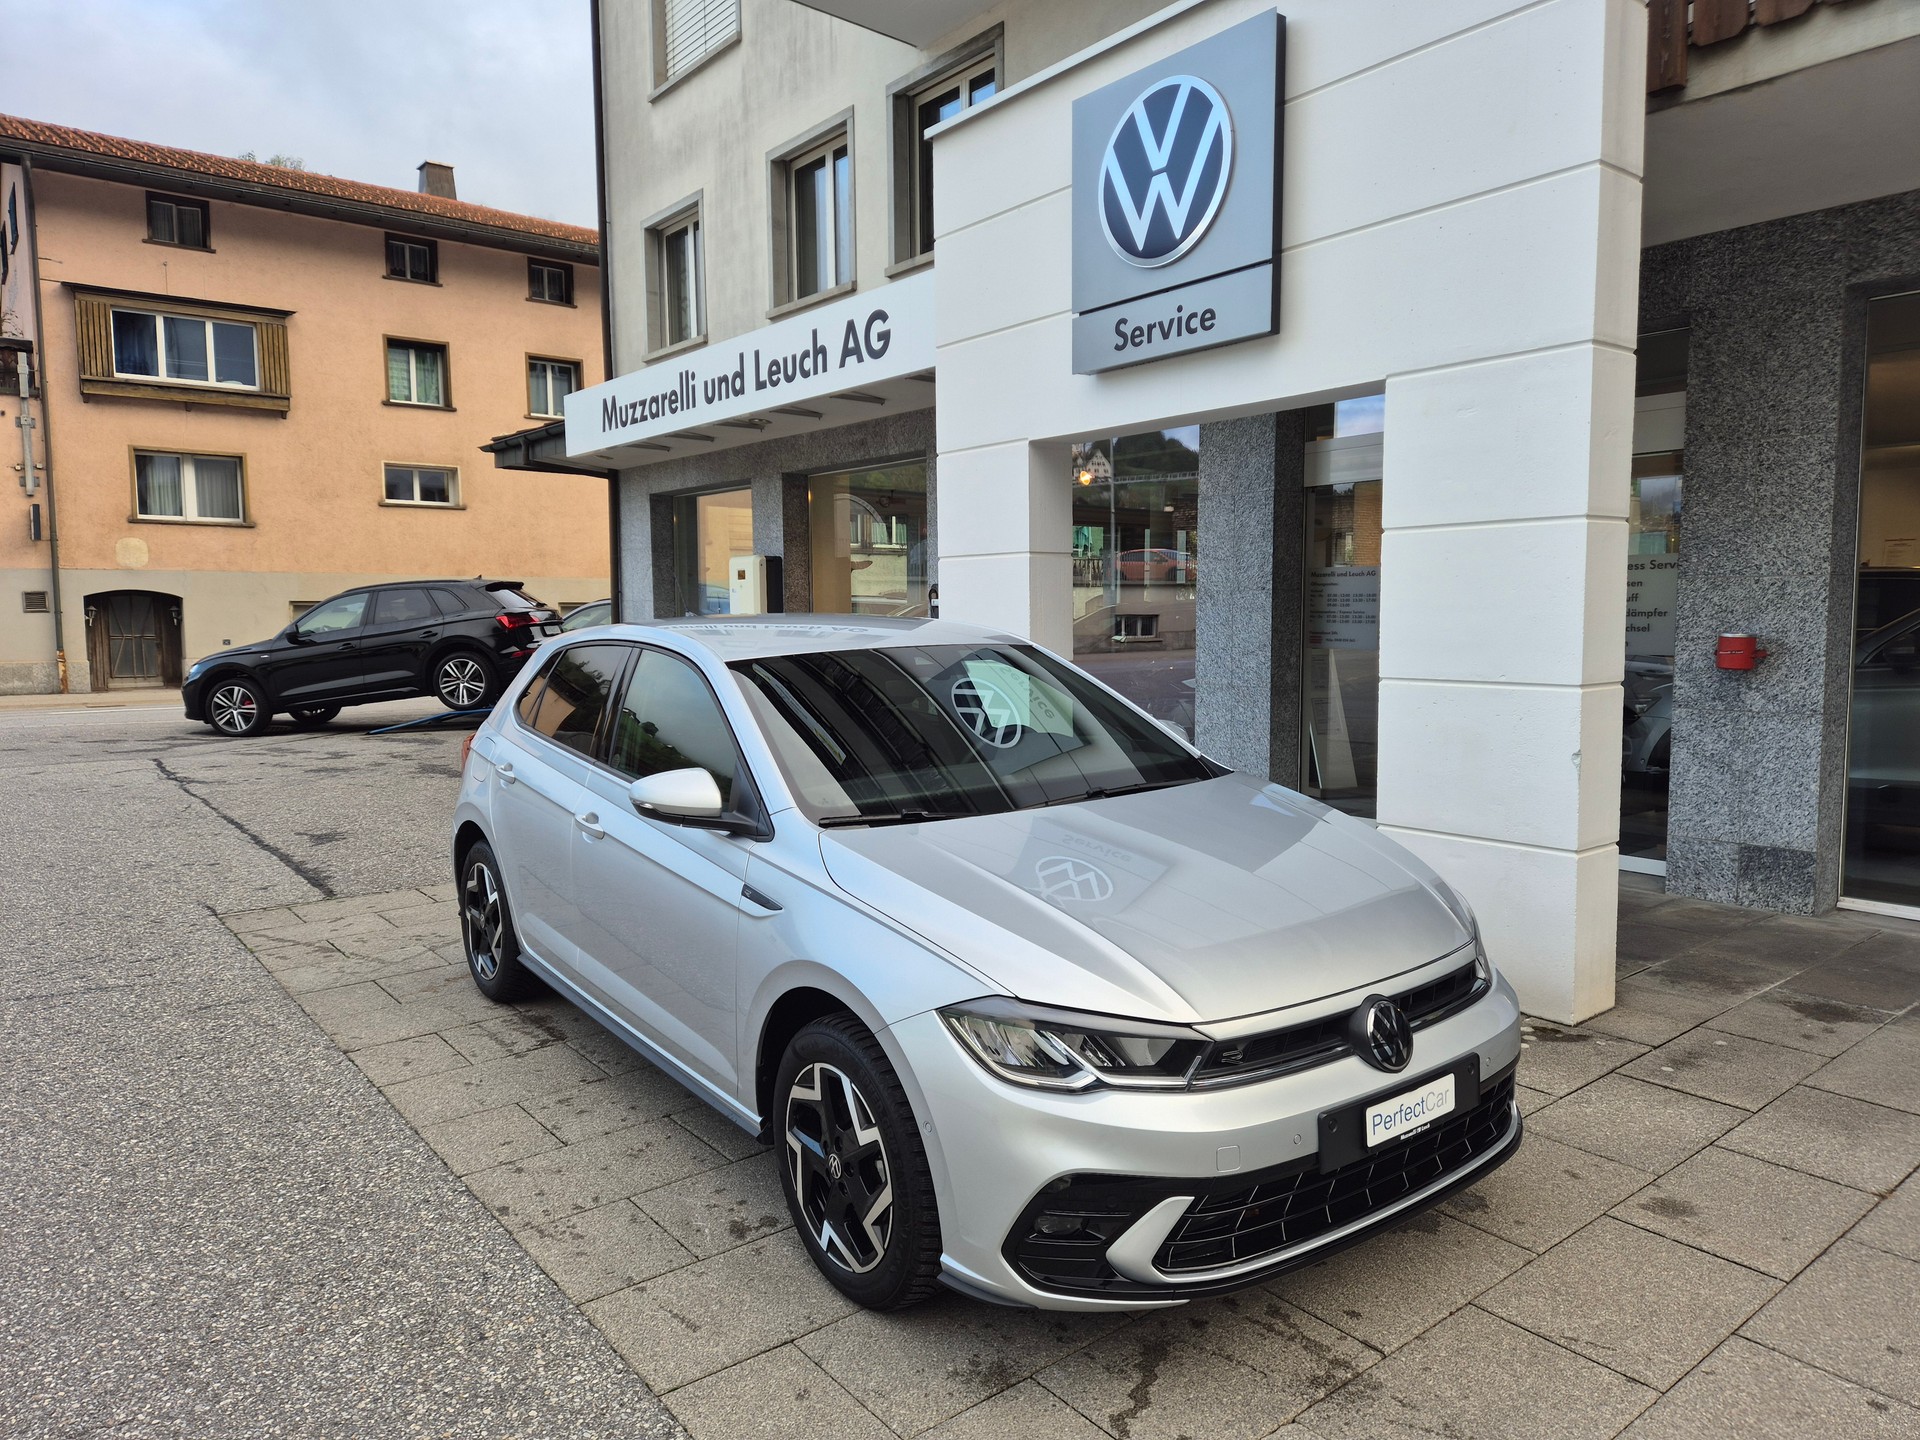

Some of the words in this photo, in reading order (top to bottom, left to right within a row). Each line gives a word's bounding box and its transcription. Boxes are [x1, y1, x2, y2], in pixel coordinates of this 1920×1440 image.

[1113, 304, 1217, 352] Service
[601, 369, 696, 433] Muzzarelli
[703, 352, 745, 405] und
[753, 328, 828, 391] Leuch
[838, 308, 892, 369] AG
[1372, 1088, 1450, 1136] PerfectCar
